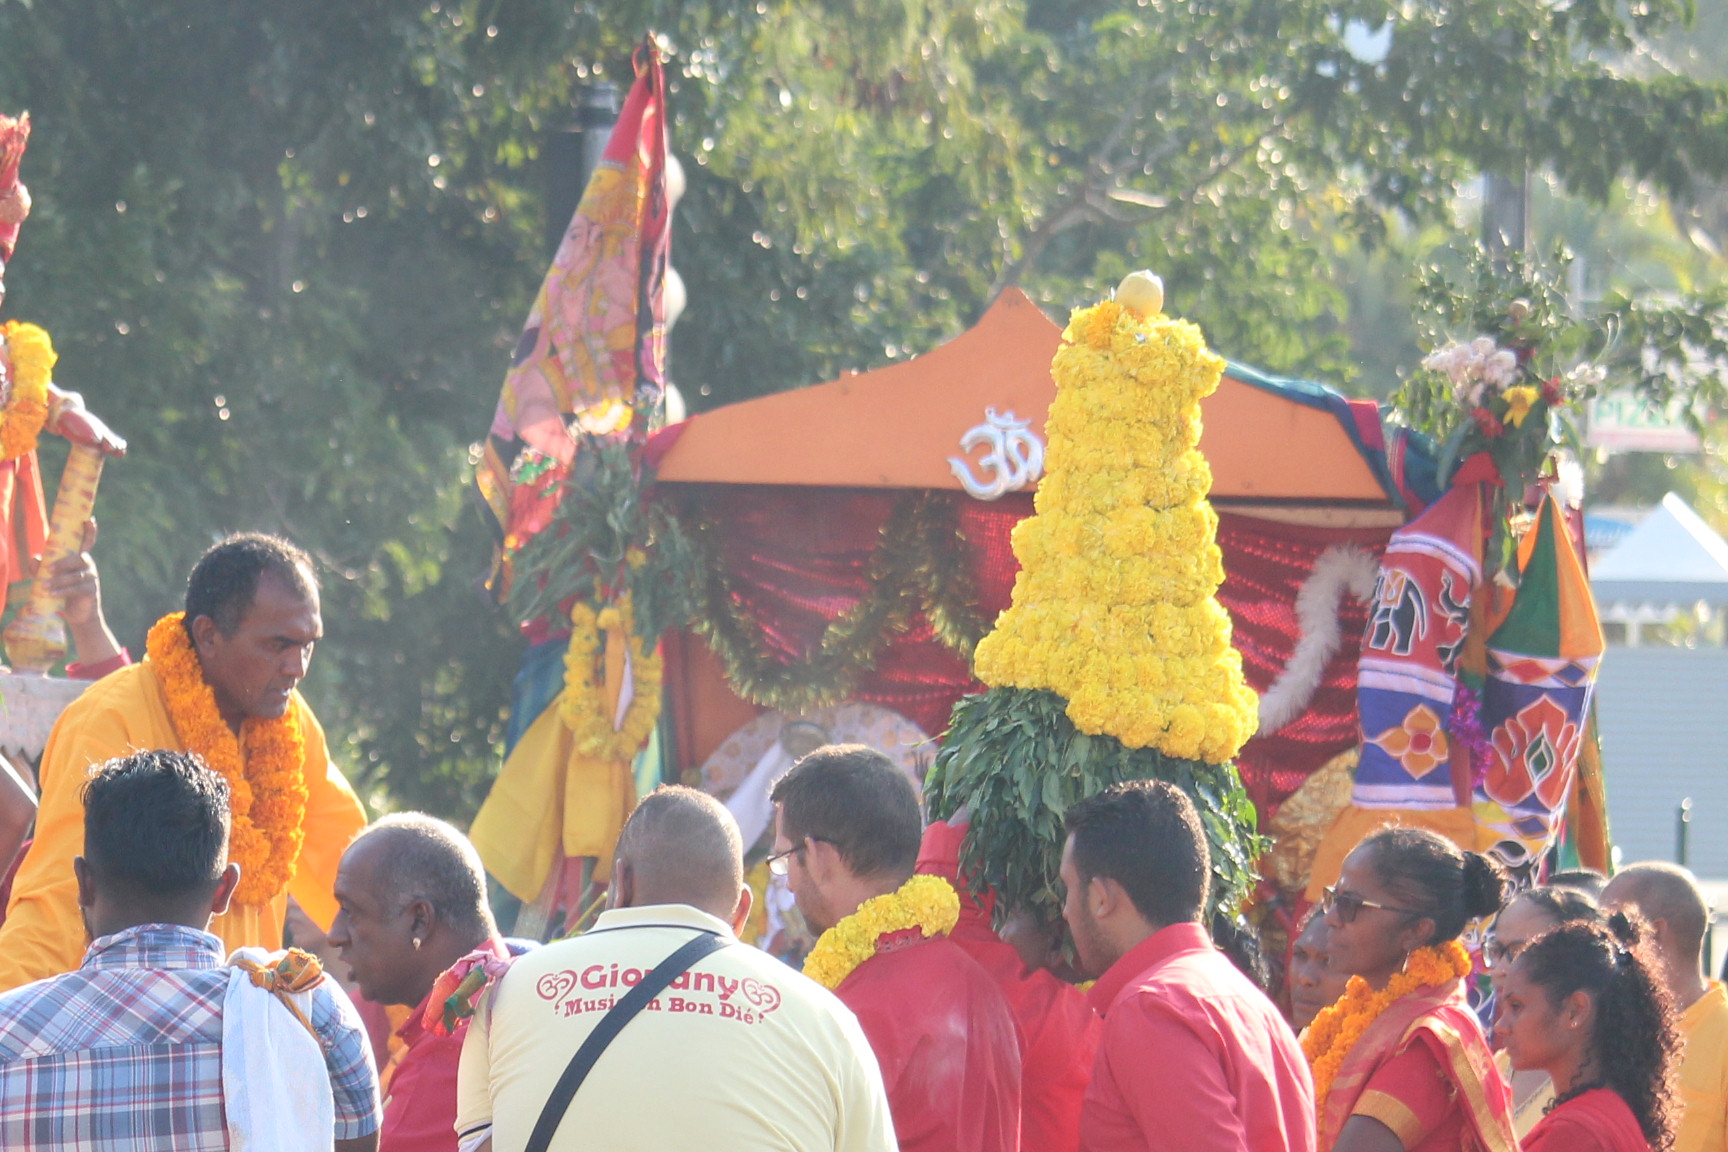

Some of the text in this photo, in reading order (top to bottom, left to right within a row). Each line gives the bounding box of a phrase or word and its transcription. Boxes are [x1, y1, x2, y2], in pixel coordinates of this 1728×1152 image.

[1596, 398, 1685, 427] PIZ
[580, 963, 739, 1000] Gioany
[564, 994, 754, 1025] Musin Bon Dié
